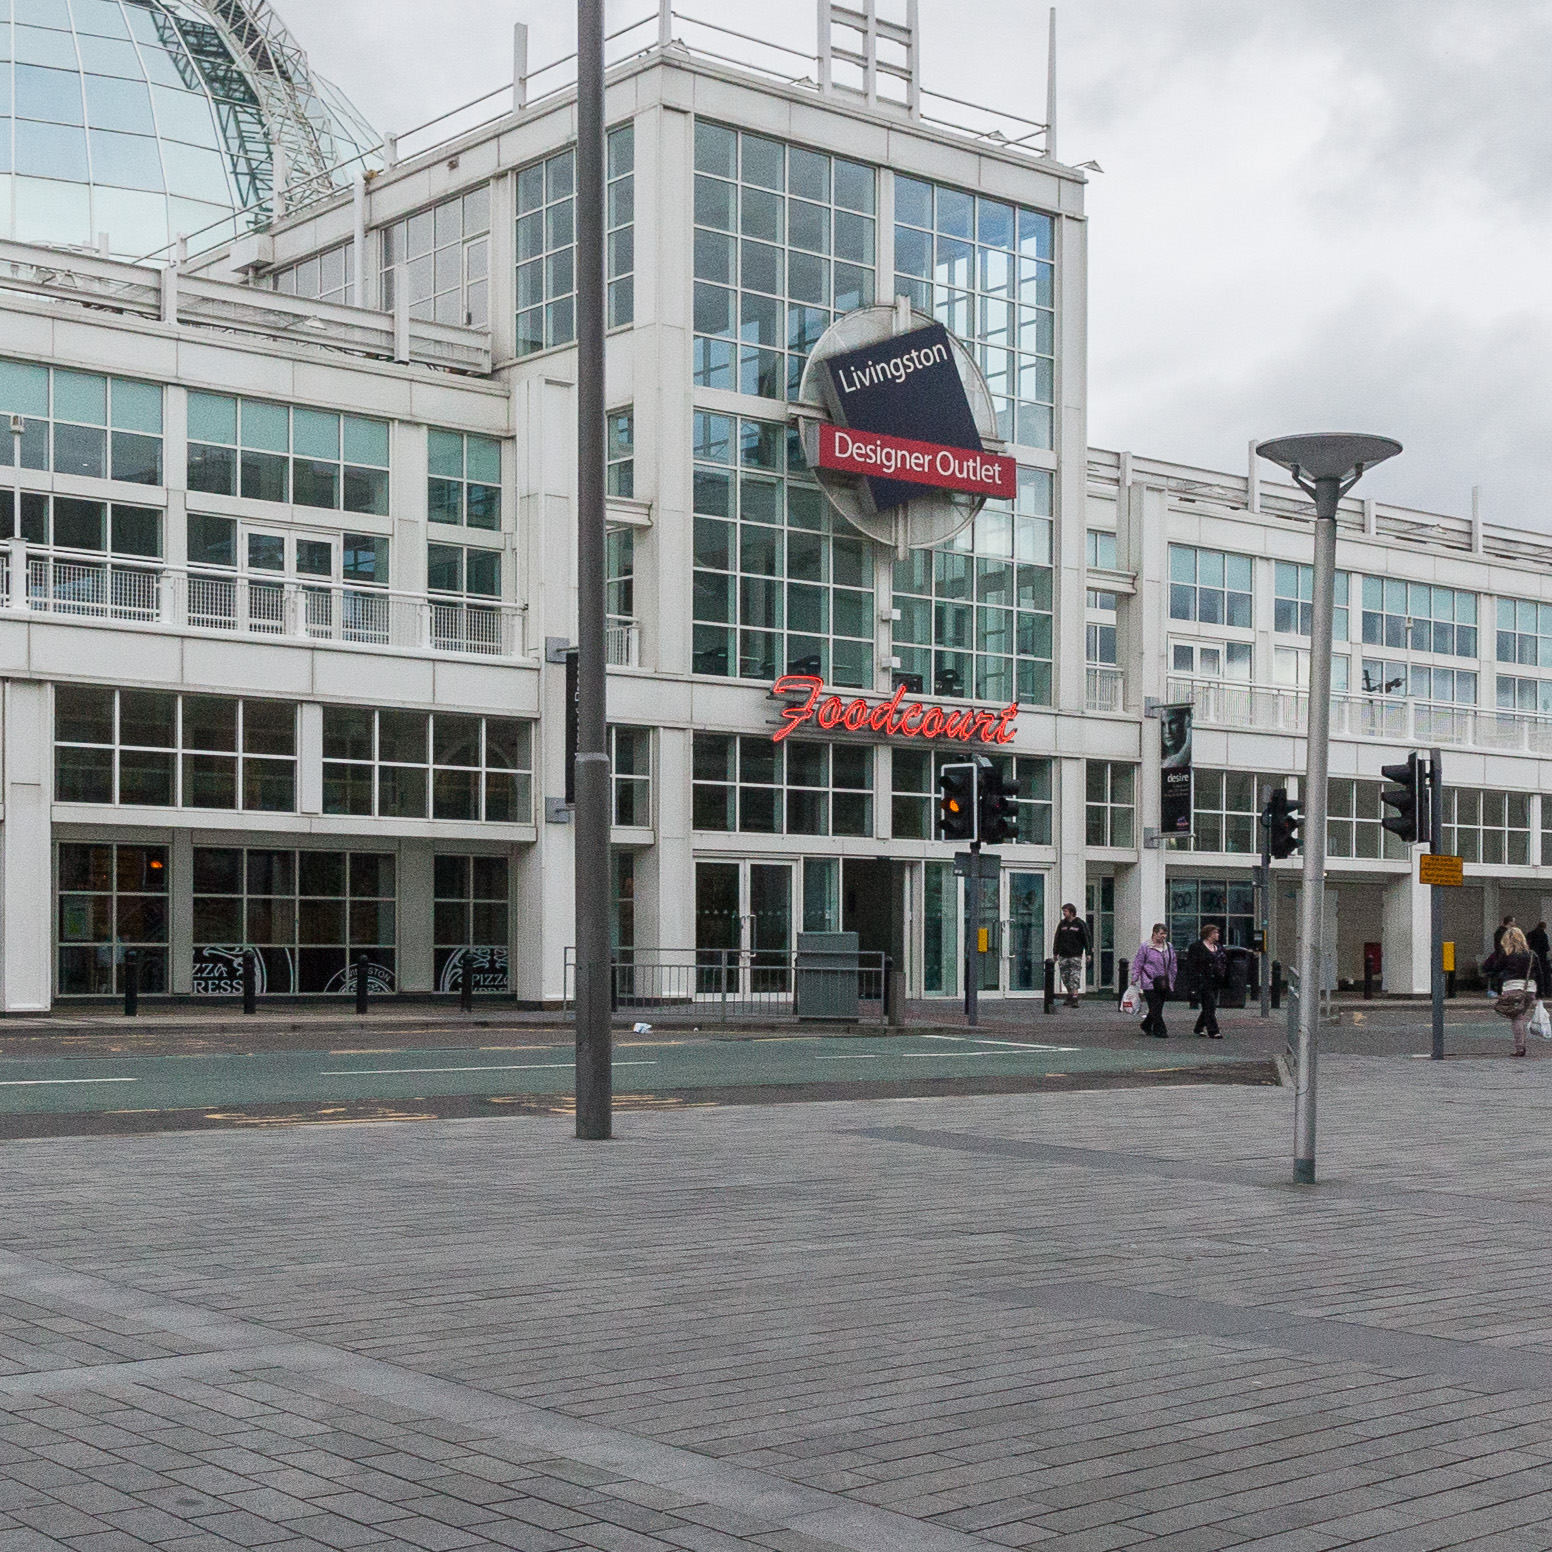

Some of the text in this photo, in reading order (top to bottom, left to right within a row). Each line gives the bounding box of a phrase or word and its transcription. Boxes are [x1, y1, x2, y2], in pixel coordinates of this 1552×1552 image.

[838, 343, 948, 393] Livingston
[834, 431, 1003, 485] Designer Outlet
[771, 674, 1020, 743] Foodcourt
[1167, 773, 1190, 783] desire
